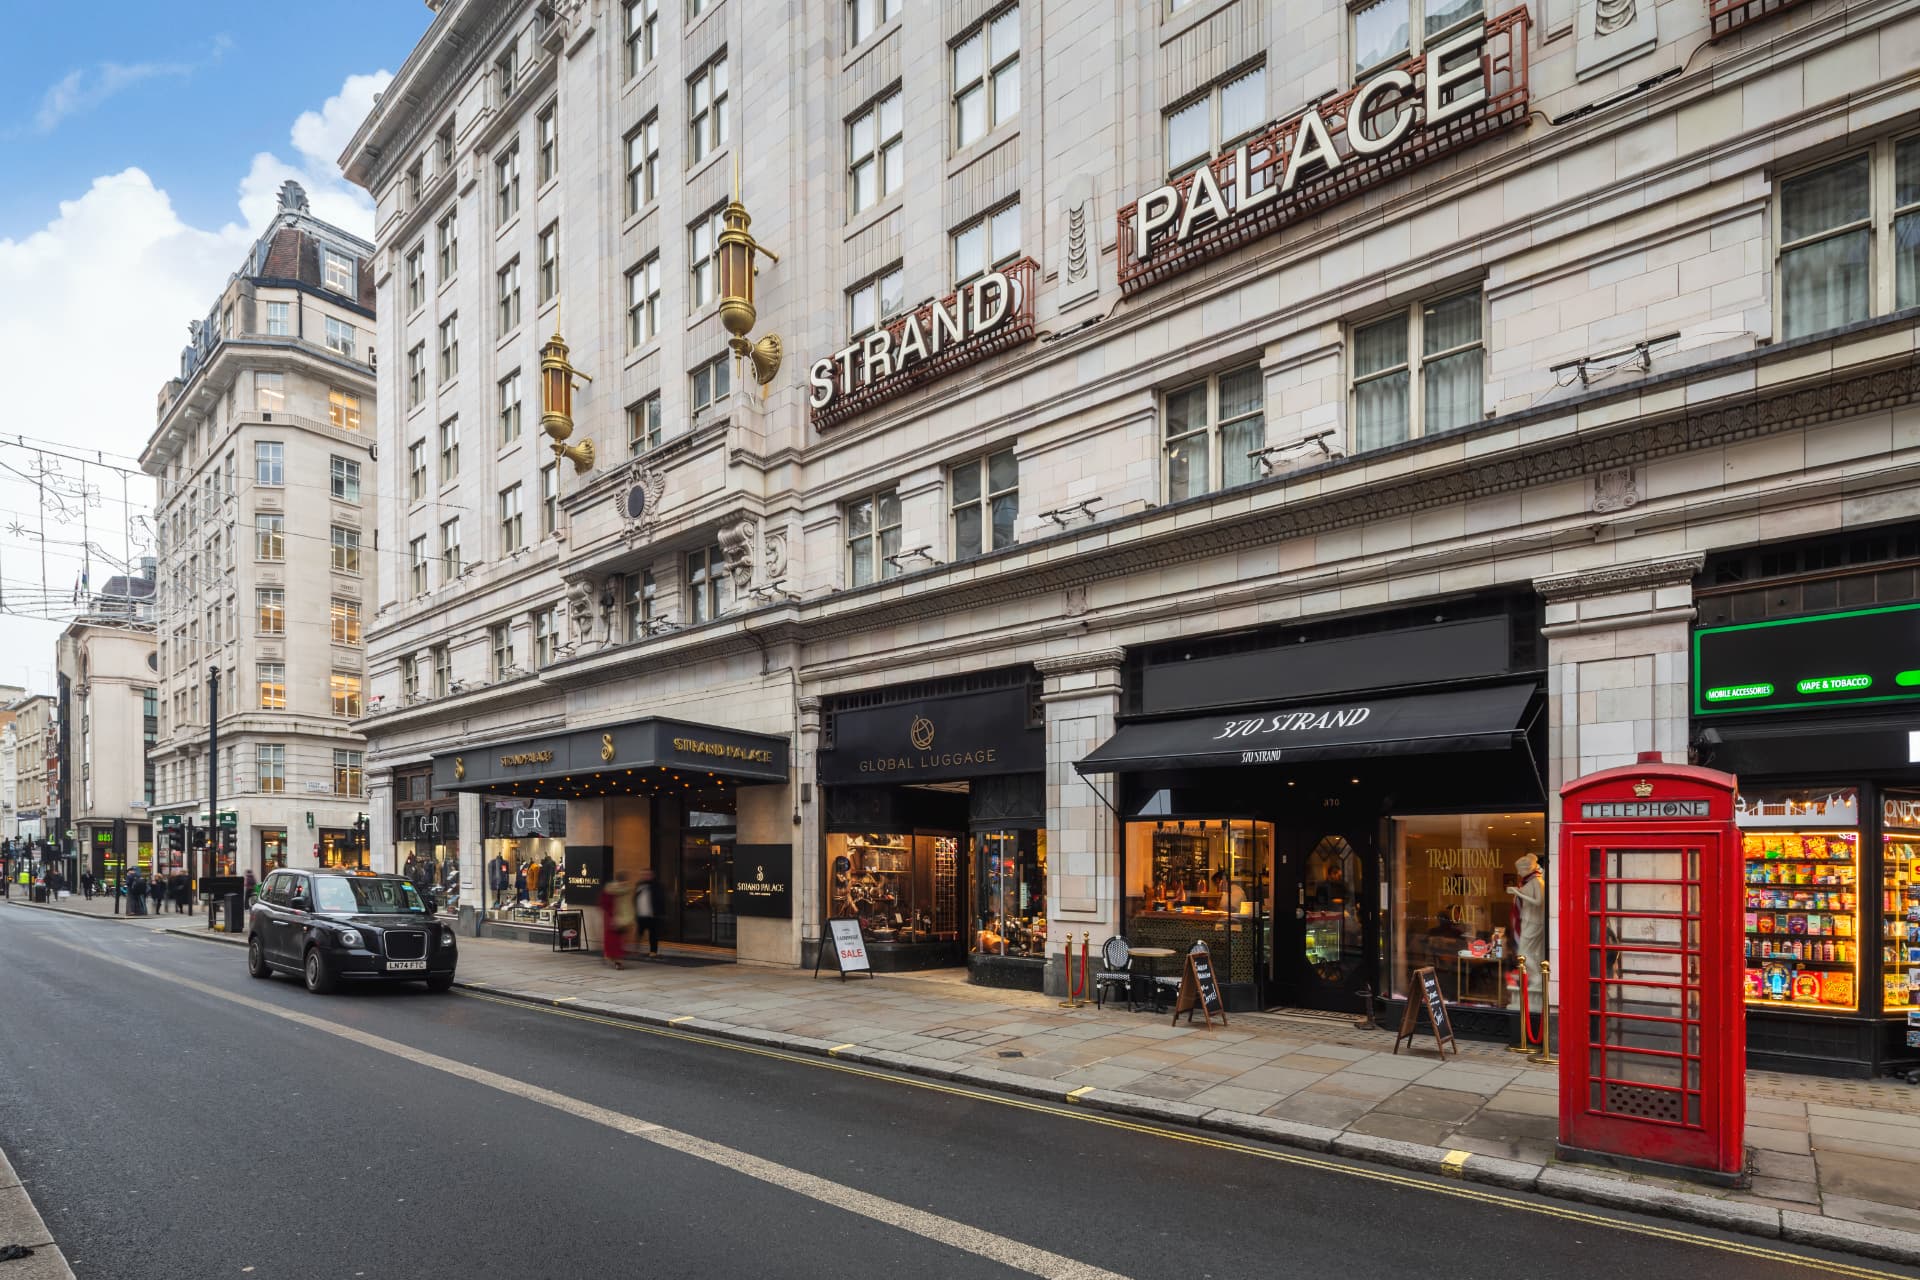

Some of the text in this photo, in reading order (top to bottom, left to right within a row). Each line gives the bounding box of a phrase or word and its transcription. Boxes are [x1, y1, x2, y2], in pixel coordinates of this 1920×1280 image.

[810, 24, 1491, 409] STRAND PALACE
[1800, 677, 1869, 691] VAPE & TOBACCO
[1708, 686, 1770, 698] MOBILE ACCESSORIES
[1212, 707, 1371, 740] 370 STRAND
[673, 737, 773, 763] STRAND PALACE
[1255, 748, 1281, 763] STRAND
[859, 749, 996, 772] GLOBAL LUGGAGE
[1586, 802, 1705, 817] TELEPHONE
[1428, 849, 1503, 869] TRADITIONAL
[737, 882, 784, 892] STRAND PALACE
[1442, 876, 1488, 897] BRITISH
[841, 949, 863, 958] SALE
[389, 961, 409, 970] LN74
